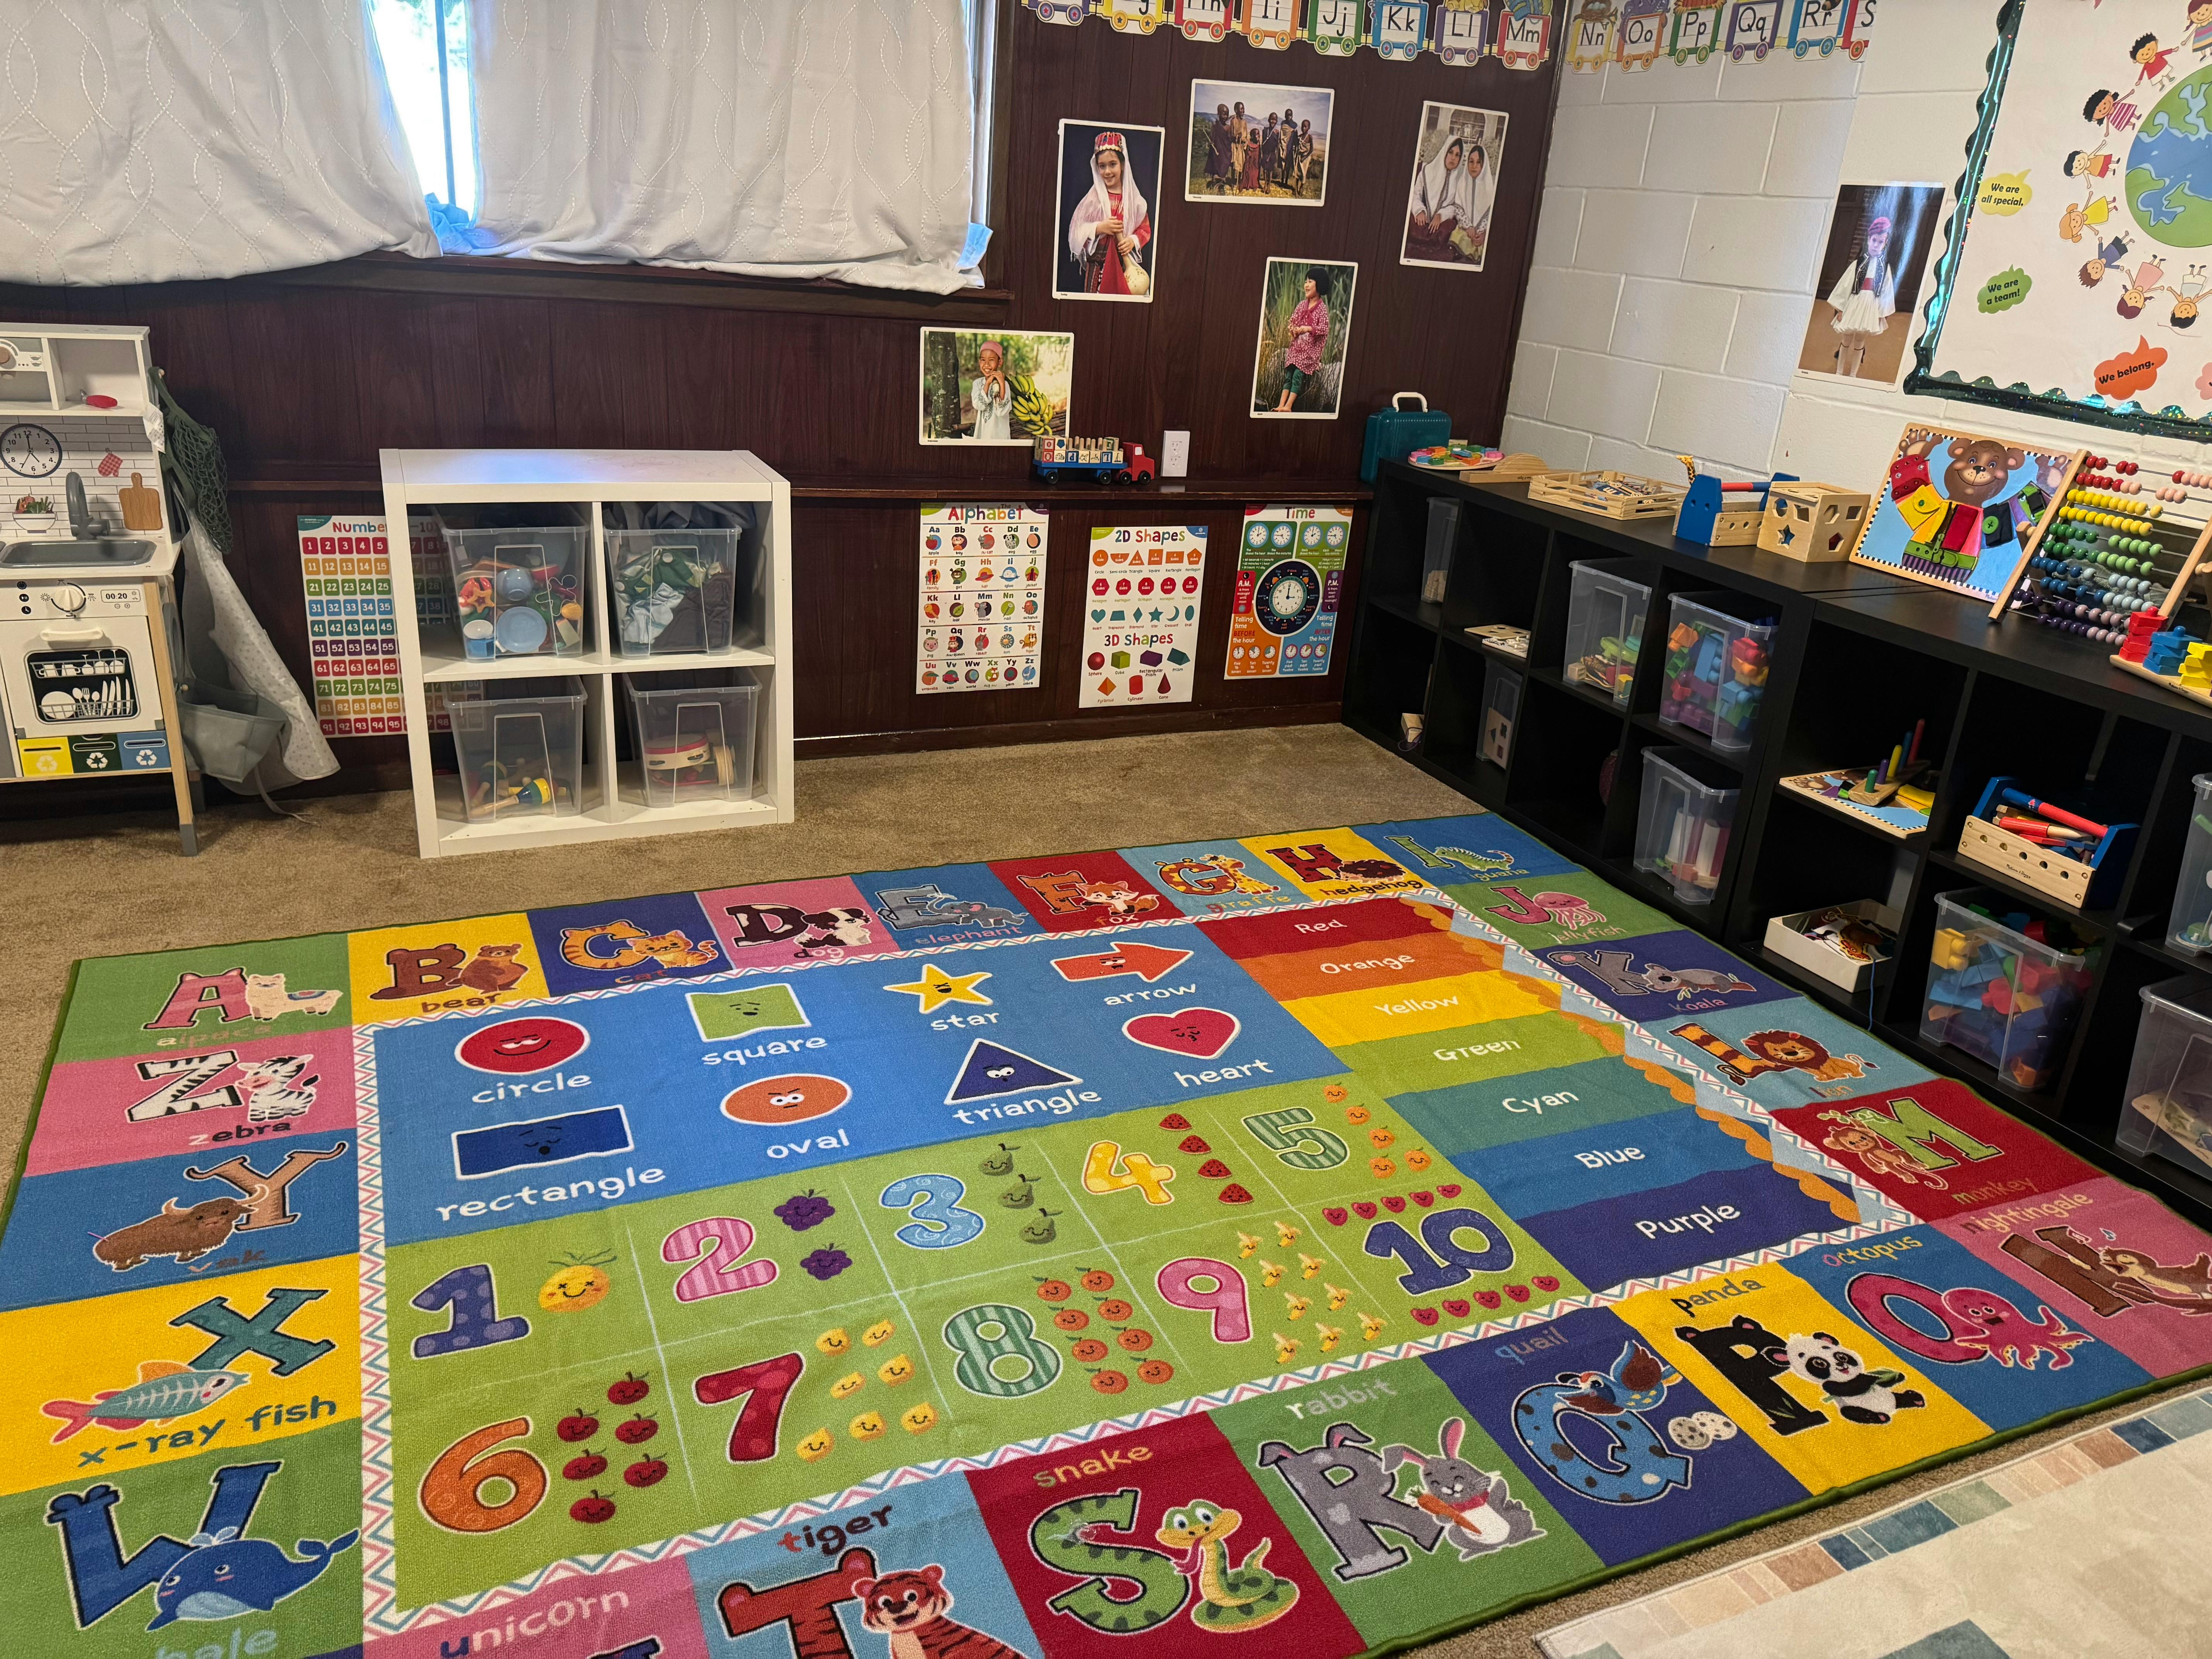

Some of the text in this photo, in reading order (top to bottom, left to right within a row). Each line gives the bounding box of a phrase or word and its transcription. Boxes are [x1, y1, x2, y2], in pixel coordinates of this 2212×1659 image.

[1322, 0, 1348, 36] Jj
[1388, 6, 1414, 31] Kk
[1451, 11, 1472, 38] Ll
[1506, 18, 1540, 44] Mm
[1683, 11, 1707, 47] Pp
[1738, 7, 1767, 42] Qq
[1802, 0, 1832, 28] Rr
[1861, 0, 1877, 27] S
[1581, 22, 1604, 46] Nn
[1628, 21, 1653, 44] Oo
[1981, 195, 2024, 207] all special.
[1991, 183, 2020, 194] We are
[1986, 289, 2021, 306] a team!
[1987, 278, 2019, 294] We are
[2099, 360, 2155, 385] We belong.
[948, 505, 1024, 524] Alphabet
[1285, 506, 1316, 519] Time
[1115, 529, 1185, 545] 2D Shapes
[1104, 633, 1173, 648] 3D Shapes
[1265, 843, 1345, 883] H
[1383, 835, 1455, 869] I
[1017, 870, 1088, 915] F
[1153, 857, 1238, 896] G
[1319, 879, 1423, 897] hedgehog
[1470, 867, 1530, 883] iguana
[874, 884, 964, 930] E
[1093, 915, 1140, 926] fox
[1205, 893, 1291, 914] giraffe
[1484, 885, 1552, 924] J
[724, 903, 812, 948] D
[915, 926, 1022, 945] elephant
[1296, 919, 1348, 934] Red
[1547, 924, 1627, 945] jellyfish
[560, 919, 653, 971] C
[793, 947, 845, 960] dog
[368, 943, 467, 1000] B
[615, 969, 668, 984] cat
[1319, 951, 1415, 976] Orange
[1546, 949, 1650, 997] K
[142, 967, 254, 1030] A
[421, 993, 497, 1013] bear
[1103, 981, 1197, 1007] arrow
[1373, 993, 1460, 1018] Yellow
[930, 1010, 1000, 1032] star
[701, 1035, 828, 1067] square
[1432, 1037, 1522, 1062] Green
[1667, 1021, 1783, 1086] L
[125, 1049, 243, 1123] Z
[471, 1071, 593, 1104] circle
[1173, 1058, 1274, 1087] heart
[952, 1087, 1103, 1126] triangle
[1500, 1088, 1580, 1116] Cyan
[189, 1121, 291, 1146] zebra
[765, 1128, 850, 1160] oval
[1242, 1105, 1351, 1171] 5
[1849, 1096, 2005, 1172] M
[1080, 1139, 1176, 1205] 4
[1573, 1144, 1646, 1169] Blue
[184, 1142, 348, 1231] Y
[435, 1165, 666, 1221] rectangle
[1951, 1176, 2038, 1206] monkey
[878, 1172, 986, 1250] 3
[1633, 1201, 1741, 1240] Purple
[1960, 1190, 2094, 1235] nightingale
[661, 1216, 779, 1303] 2
[1361, 1207, 1516, 1296] 10
[1822, 1233, 1922, 1267] octopus
[409, 1262, 533, 1360] 1
[1155, 1256, 1253, 1345] 9
[1670, 1277, 1766, 1317] panda
[168, 1288, 337, 1377] X
[1844, 1272, 1989, 1364] O
[941, 1303, 1063, 1398] 8
[1494, 1327, 1568, 1365] quail
[1674, 1315, 1831, 1436] P
[695, 1352, 805, 1464] 7
[1285, 1377, 1398, 1419] rabbit
[78, 1395, 337, 1468] x-ray fish
[1511, 1382, 1693, 1505] Q
[417, 1415, 550, 1534] 6
[1034, 1443, 1153, 1487] snake
[1257, 1422, 1445, 1582] R
[43, 1460, 284, 1630] W
[776, 1502, 893, 1555] tiger
[1027, 1487, 1191, 1635] S
[716, 1547, 877, 1659] T
[440, 1590, 629, 1658] unicorn
